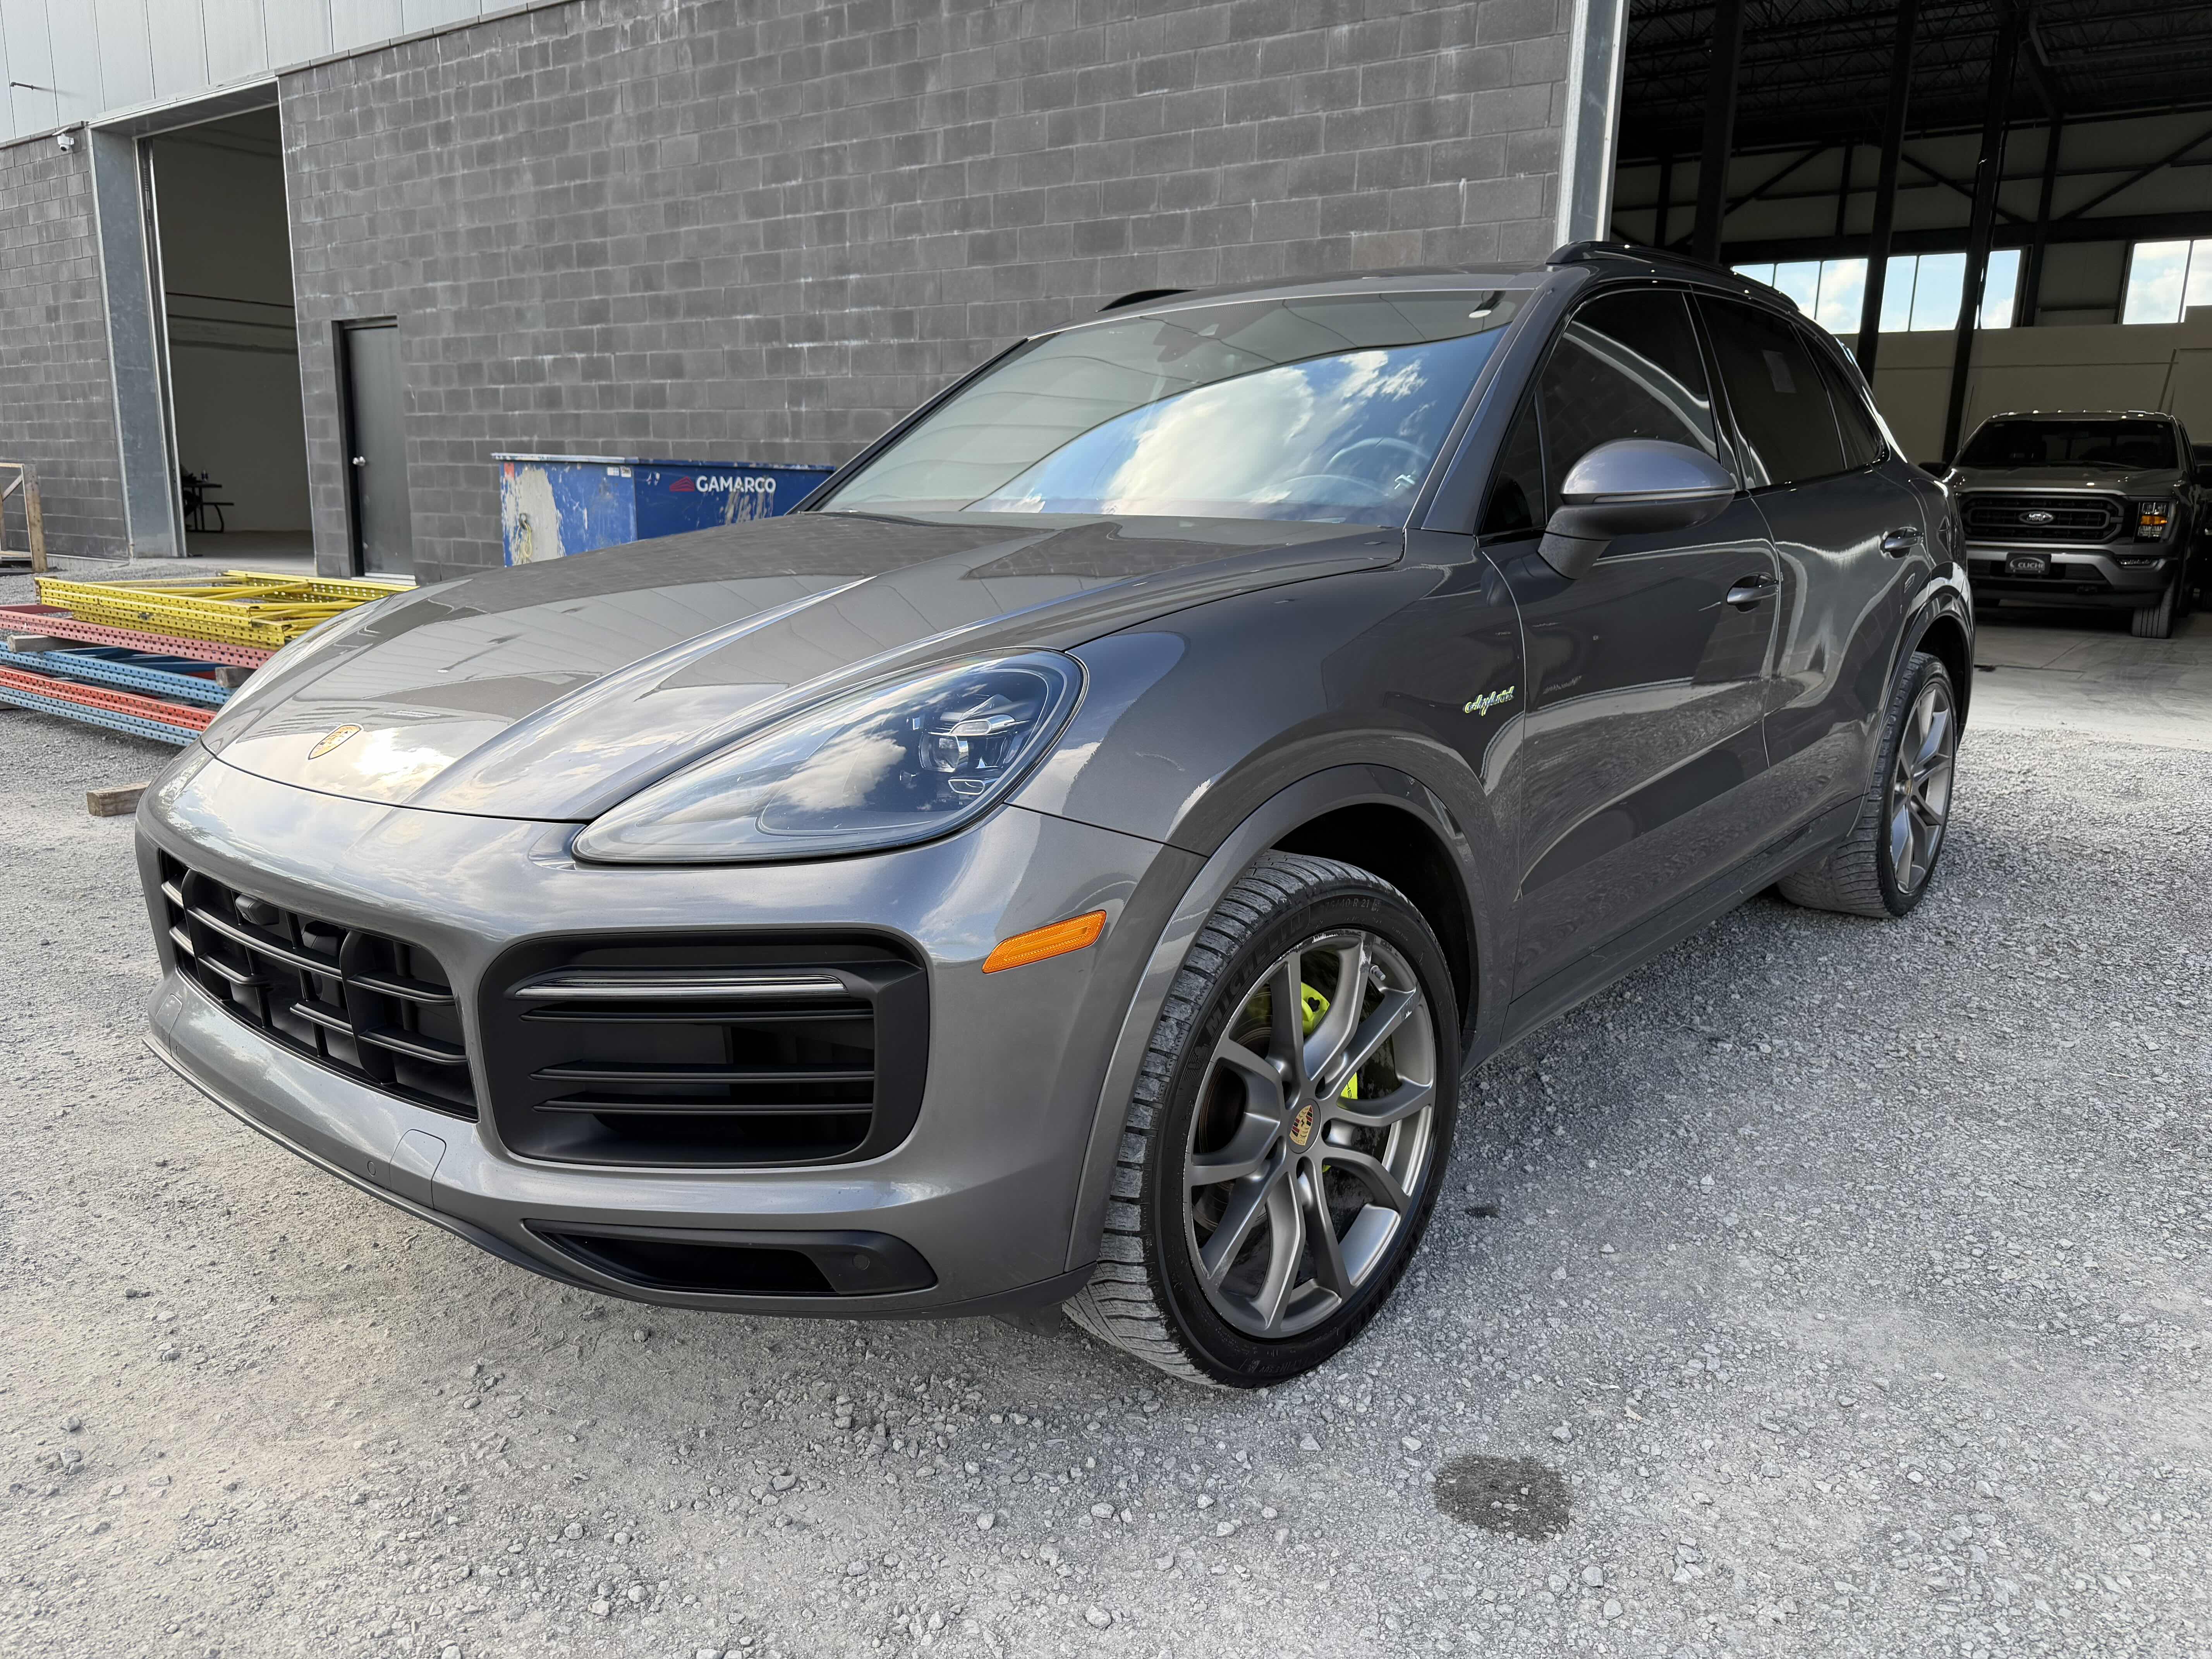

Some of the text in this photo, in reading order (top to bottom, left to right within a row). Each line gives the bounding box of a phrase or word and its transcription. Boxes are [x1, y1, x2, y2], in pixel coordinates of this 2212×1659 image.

[696, 476, 776, 493] GAMARCO
[1353, 898, 1358, 907] R
[1361, 898, 1370, 908] 21
[1205, 912, 1302, 1038] MICHELIN
